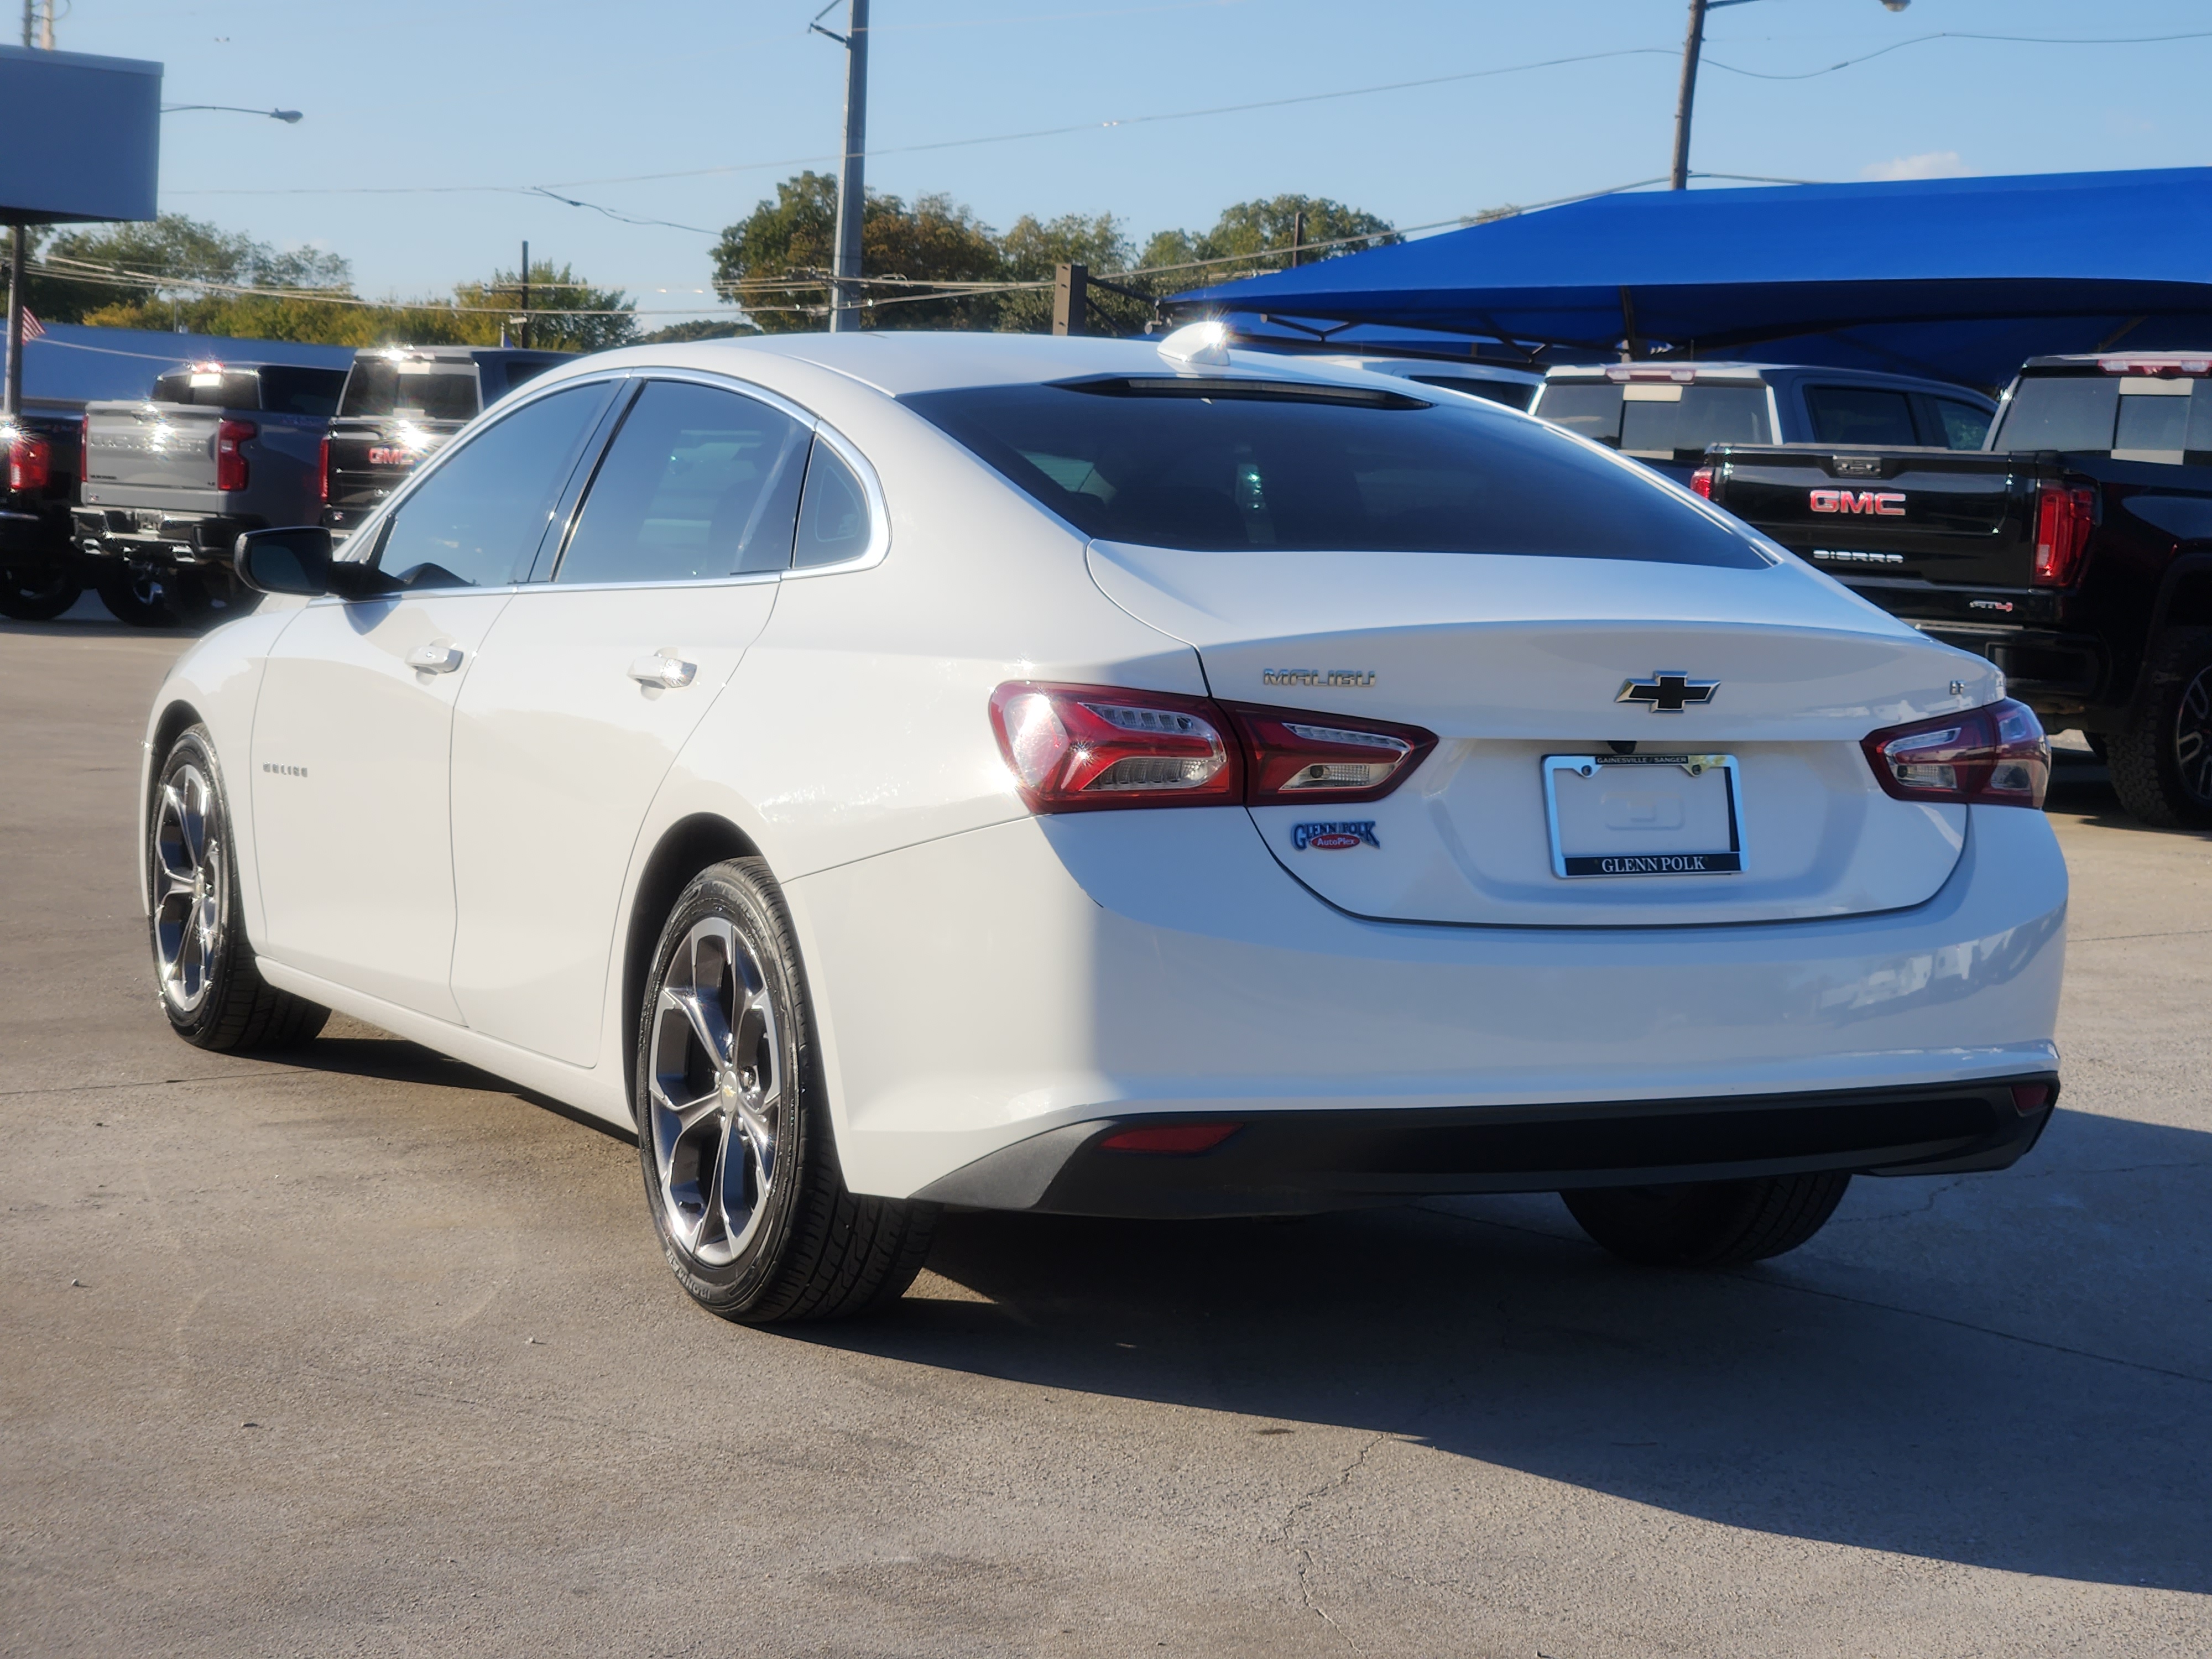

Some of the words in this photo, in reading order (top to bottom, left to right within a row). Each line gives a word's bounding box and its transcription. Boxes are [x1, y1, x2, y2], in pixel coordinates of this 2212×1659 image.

[369, 447, 415, 465] GMC
[1810, 490, 1906, 515] GMC
[1813, 550, 1903, 564] SIERRA
[1969, 600, 2013, 613] AT4
[1264, 668, 1375, 687] MALIBU
[1292, 823, 1337, 850] GLENN
[1341, 821, 1380, 849] POLK
[1317, 837, 1355, 847] AutoPlex
[1601, 858, 1658, 873] GLENN
[1661, 856, 1706, 871] POLK
